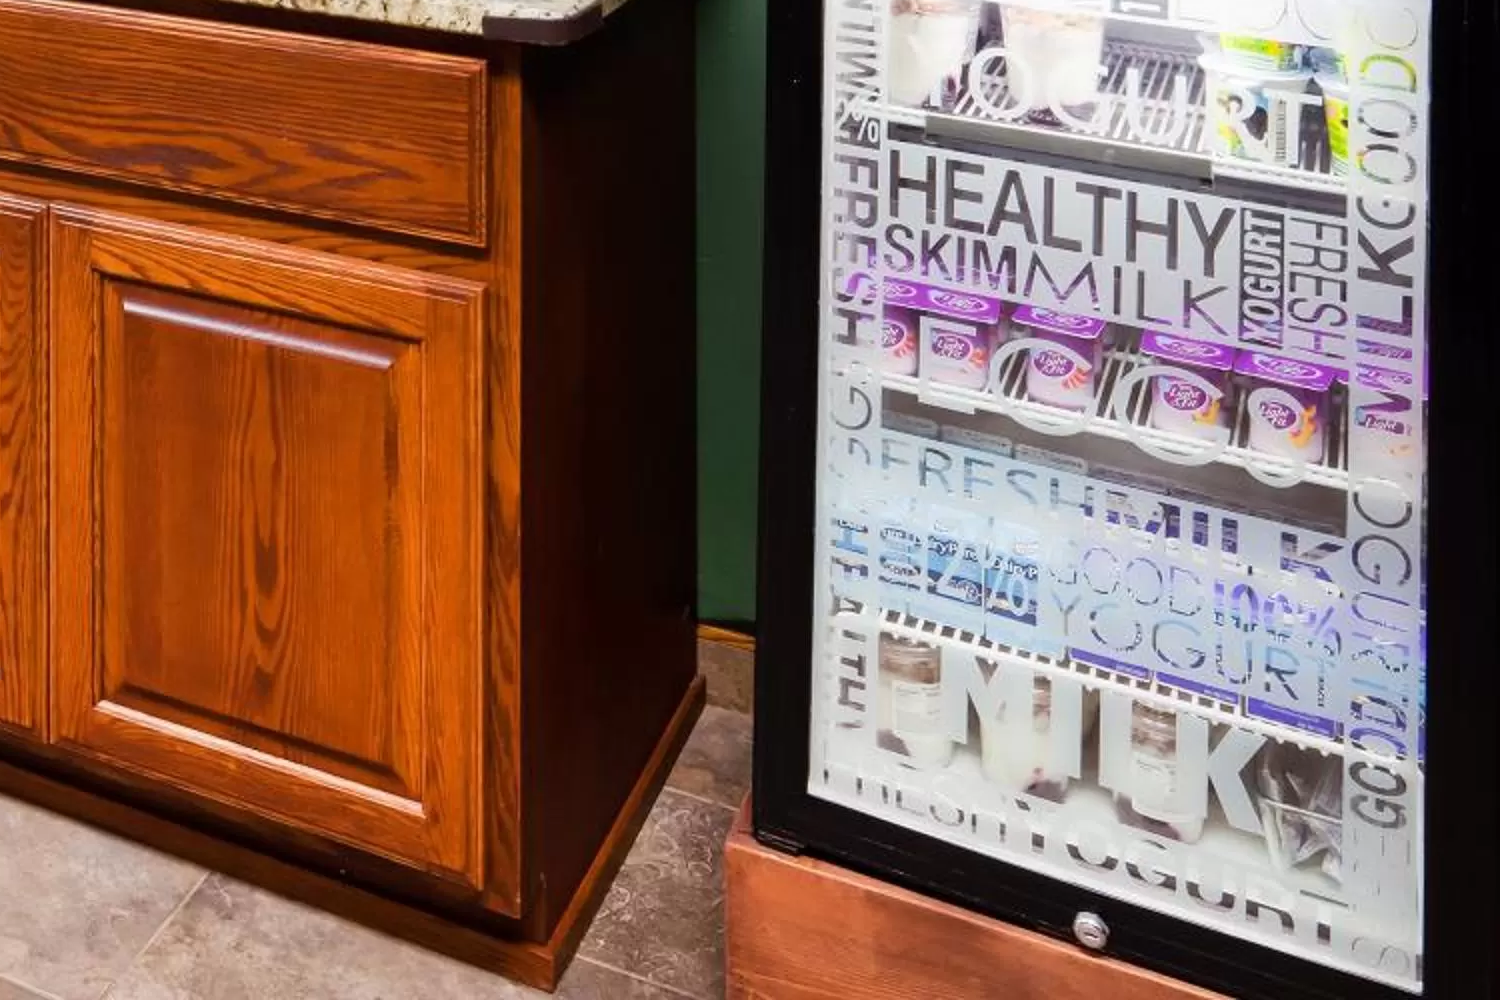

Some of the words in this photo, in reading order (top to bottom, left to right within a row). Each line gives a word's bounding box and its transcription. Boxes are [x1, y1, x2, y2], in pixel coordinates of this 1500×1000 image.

[882, 222, 1017, 295] SKIM
[1023, 249, 1229, 338] MILK
[888, 149, 1237, 279] HEALTHY
[1241, 207, 1286, 350] YOGURT
[1287, 216, 1349, 361] FRESH
[1355, 229, 1414, 436] MILK
[829, 515, 870, 730] HEATH
